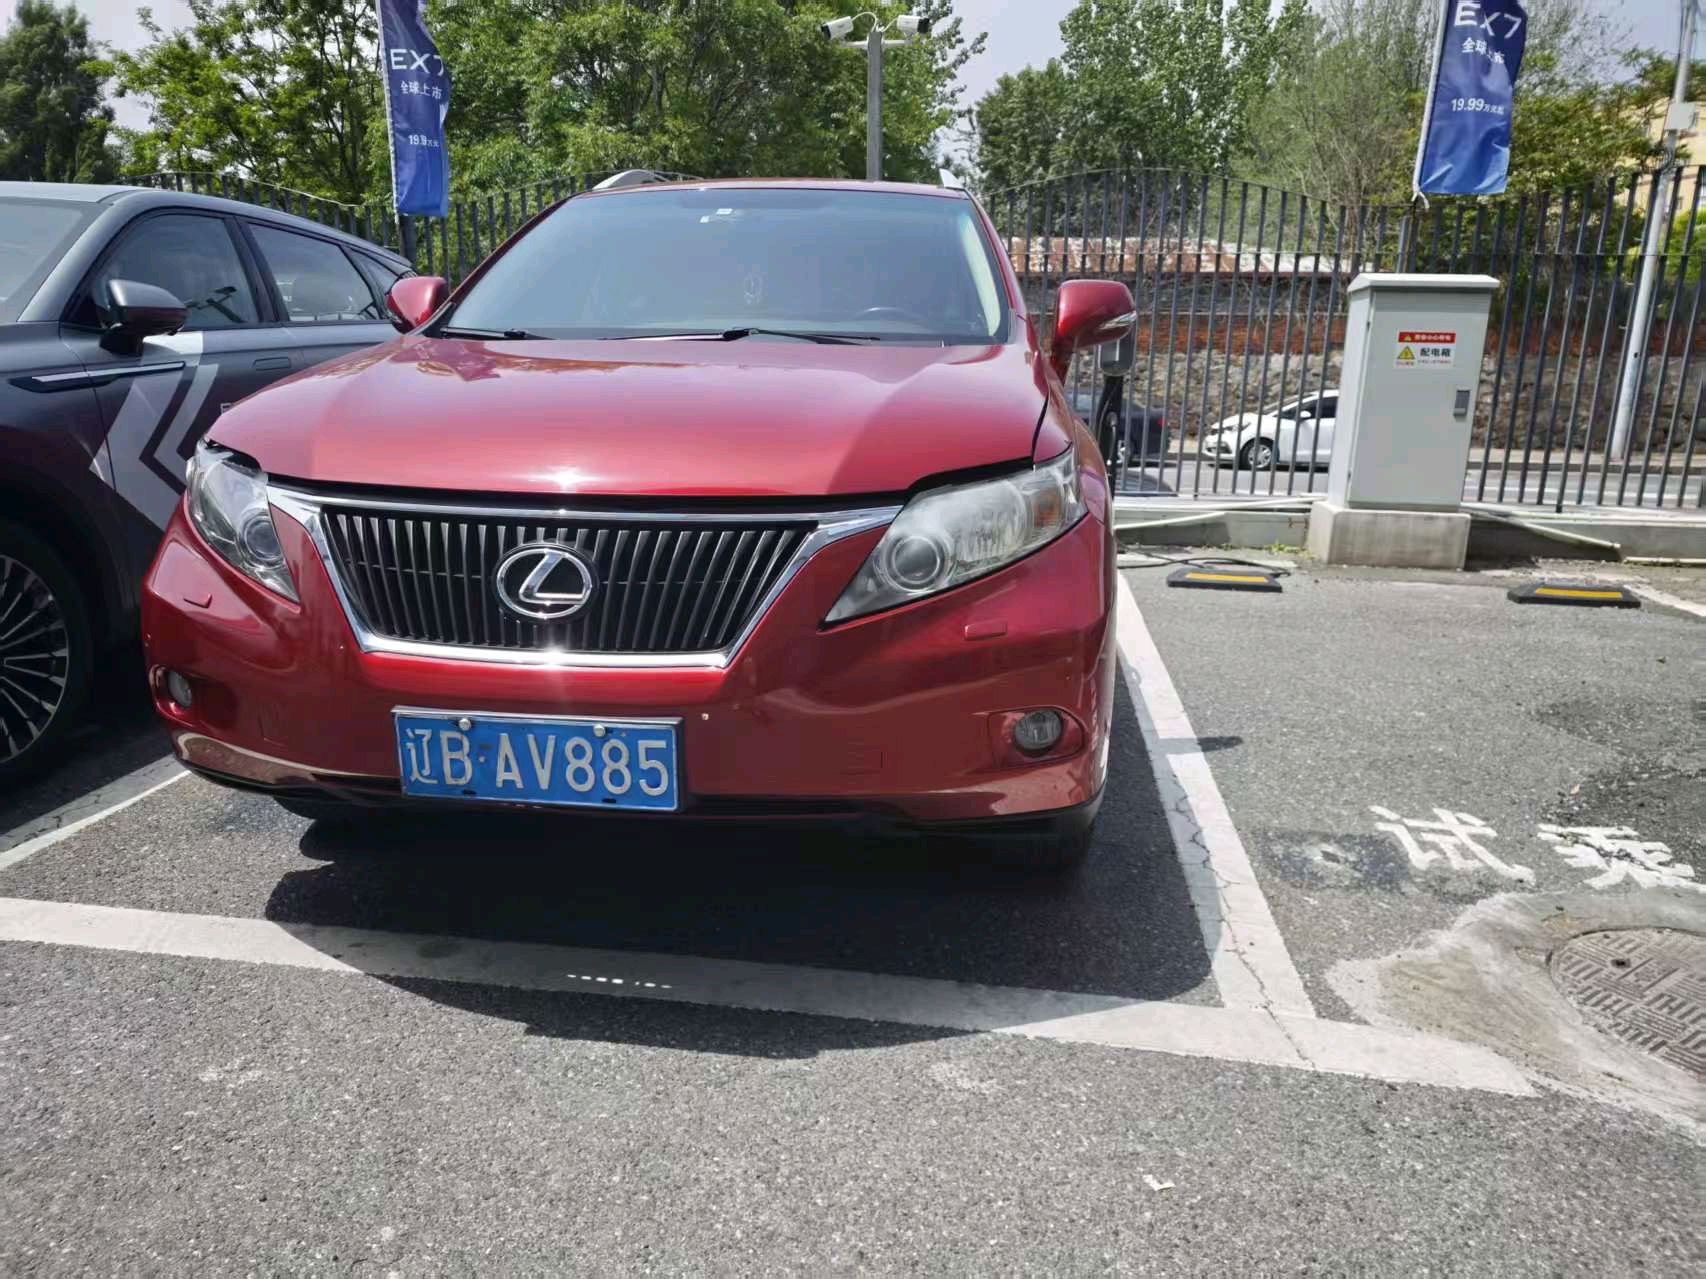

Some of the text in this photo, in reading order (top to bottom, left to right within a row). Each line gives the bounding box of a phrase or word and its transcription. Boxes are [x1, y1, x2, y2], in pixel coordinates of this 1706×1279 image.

[1454, 1, 1522, 39] EX7
[400, 80, 442, 99] 全球上市
[1420, 347, 1451, 357] 配电箱
